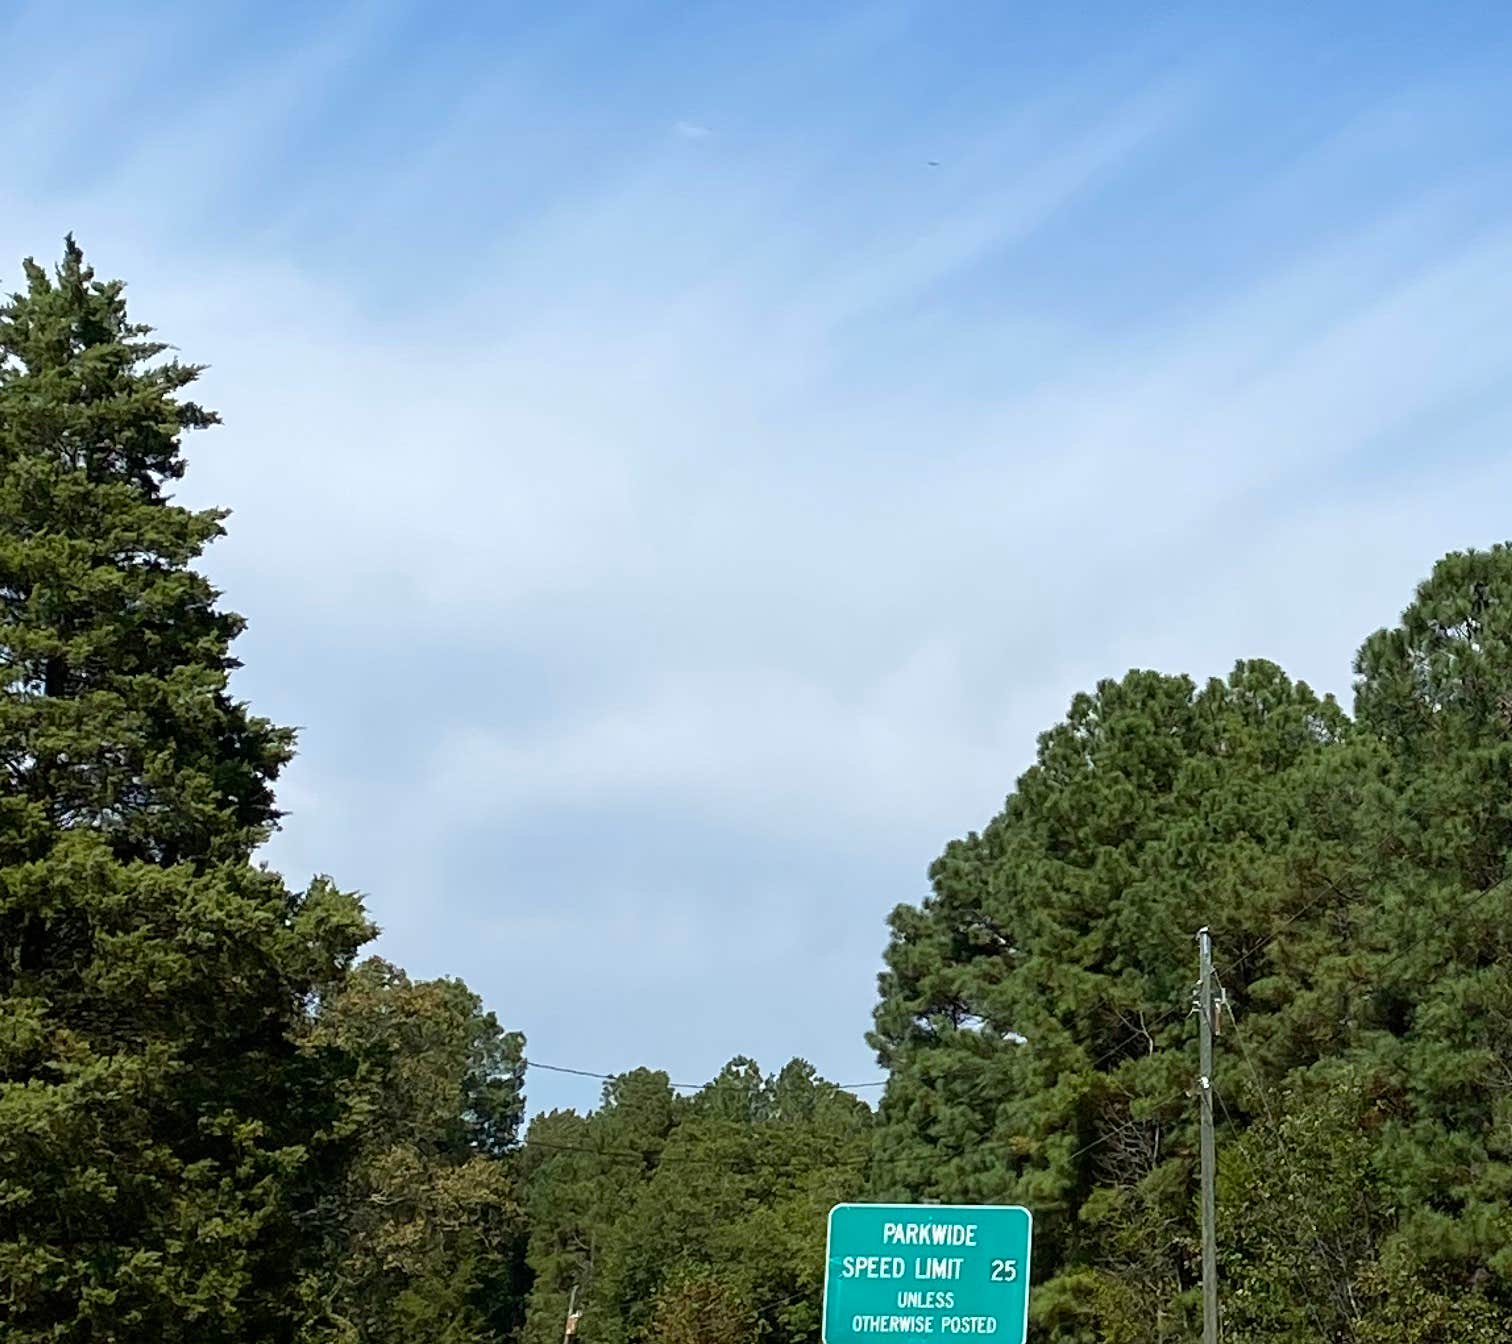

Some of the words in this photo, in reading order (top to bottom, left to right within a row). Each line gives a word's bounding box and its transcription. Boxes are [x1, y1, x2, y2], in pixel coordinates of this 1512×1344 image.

[884, 1222, 977, 1247] PARKWIDE
[842, 1257, 905, 1279] SPEED
[915, 1258, 963, 1280] LIMIT
[991, 1260, 1017, 1281] 25
[898, 1291, 954, 1309] UNLESS
[852, 1316, 933, 1333] OTHERWISE
[941, 1316, 997, 1334] POSTED
